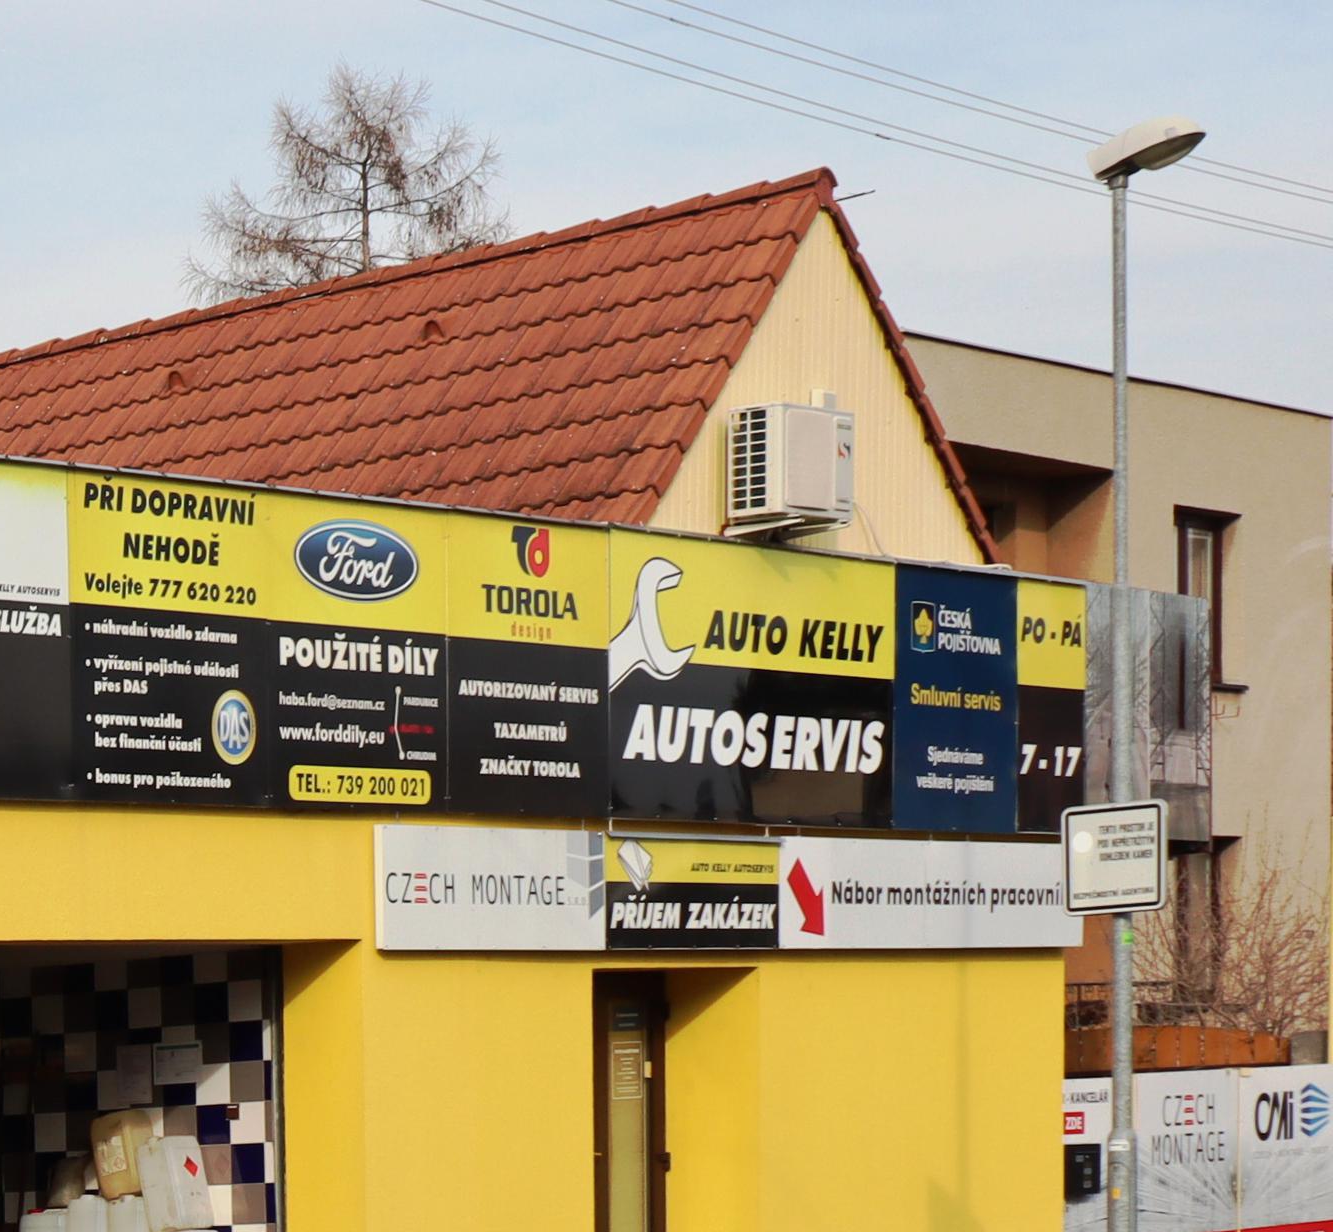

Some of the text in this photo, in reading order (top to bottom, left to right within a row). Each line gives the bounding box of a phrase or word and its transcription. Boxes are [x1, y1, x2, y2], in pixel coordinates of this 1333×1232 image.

[83, 477, 255, 526] PŘI DOPRAVNÍ
[122, 532, 220, 567] NEHODĚ
[318, 531, 397, 588] Ford
[16, 584, 60, 597] AUTOSERVIS
[85, 572, 257, 606] Volejte 777 620 220
[481, 584, 579, 621] TOROLA
[93, 618, 238, 645] náhradní vozidlo zdarma
[511, 621, 552, 641] design
[938, 604, 972, 630] ČESKÁ
[1021, 616, 1044, 644] PO
[1060, 614, 1083, 648] PÁ
[703, 610, 884, 663] AUTO KELLY
[938, 630, 1001, 656] POJIŠŤOVNA
[94, 655, 239, 679] vyřízení pojistné události
[279, 632, 439, 677] POUŽITÉ DÍLY
[94, 677, 148, 696] přes DAS
[459, 679, 599, 704] AUTORIZOVANÝ SERVIS
[910, 683, 1001, 712] Smluvní servis
[94, 713, 183, 729] oprava vozidla
[219, 708, 250, 750] DAS
[279, 722, 385, 748] www.forddily.eu
[494, 721, 567, 742] TAXAMETRŮ
[95, 732, 202, 752] bez finanční účasti
[622, 703, 885, 775] AUTOSERVIS
[480, 755, 581, 779] ZNAČKY TOROLA
[1020, 744, 1037, 775] 7
[1054, 746, 1082, 777] 17
[95, 768, 232, 789] bonus pro poškozeného
[296, 773, 425, 797] TEL.: 739 200 021
[690, 863, 709, 872] AUTO
[711, 863, 731, 872] KELLY
[385, 872, 565, 906] CZECH MONTAGE
[832, 880, 1063, 913] Nábor montážních pracovní
[610, 894, 777, 930] PŘÍJEM ZAKÁZEK
[1162, 1094, 1215, 1127] CZECH
[1151, 1131, 1225, 1166] MONTAGE
